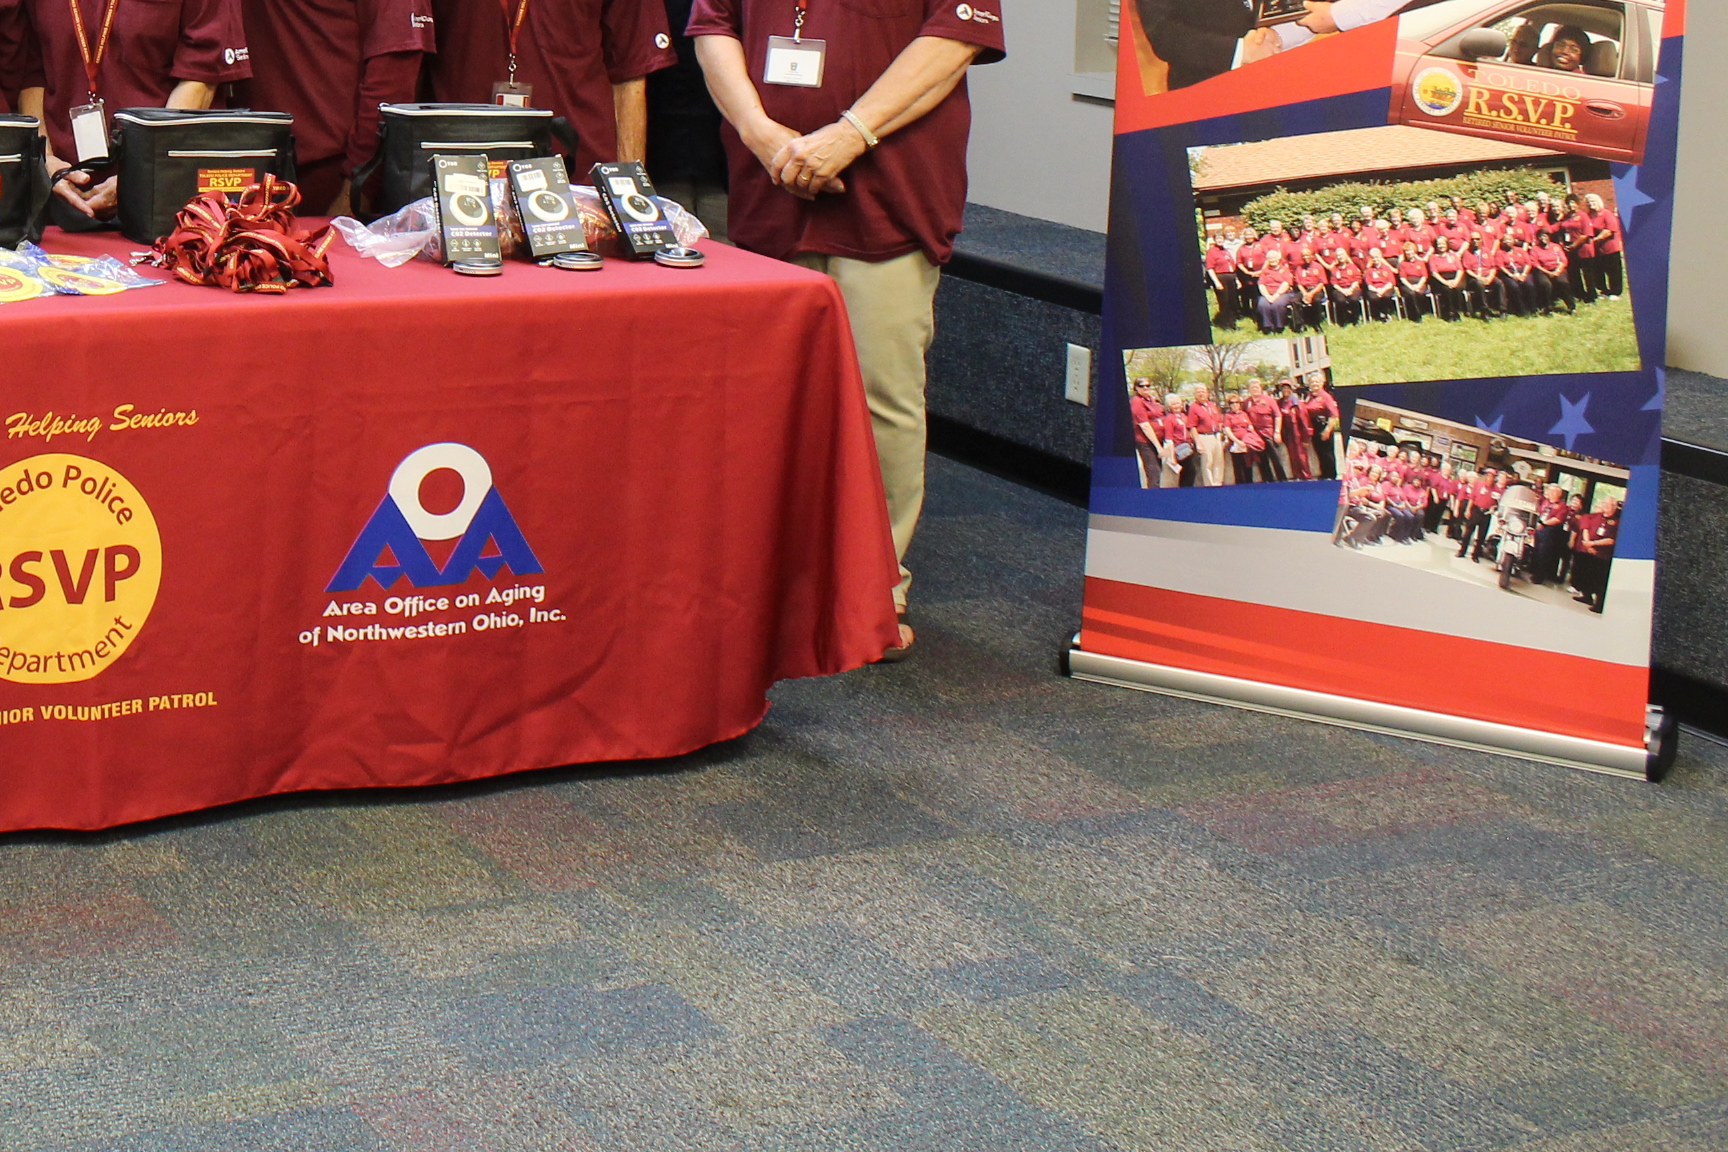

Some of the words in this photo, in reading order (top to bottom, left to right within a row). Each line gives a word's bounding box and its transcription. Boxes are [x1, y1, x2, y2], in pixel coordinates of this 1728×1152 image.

[1467, 68, 1581, 100] TOLEDO
[1464, 86, 1575, 129] R.S.V.P.
[209, 177, 242, 187] RSVP
[546, 224, 576, 232] Detector
[5, 410, 103, 443] Helping
[109, 403, 200, 431] Seniors
[61, 464, 134, 526] Police
[322, 600, 378, 618] Area
[383, 595, 450, 618] Office
[454, 593, 480, 609] on
[484, 584, 546, 605] Aging
[298, 626, 321, 647] of
[326, 619, 467, 643] Northwestern
[472, 611, 524, 632] Ohio,
[529, 607, 567, 624] Inc.
[40, 698, 144, 722] VOLUNTEER
[148, 692, 218, 712] PATROL
